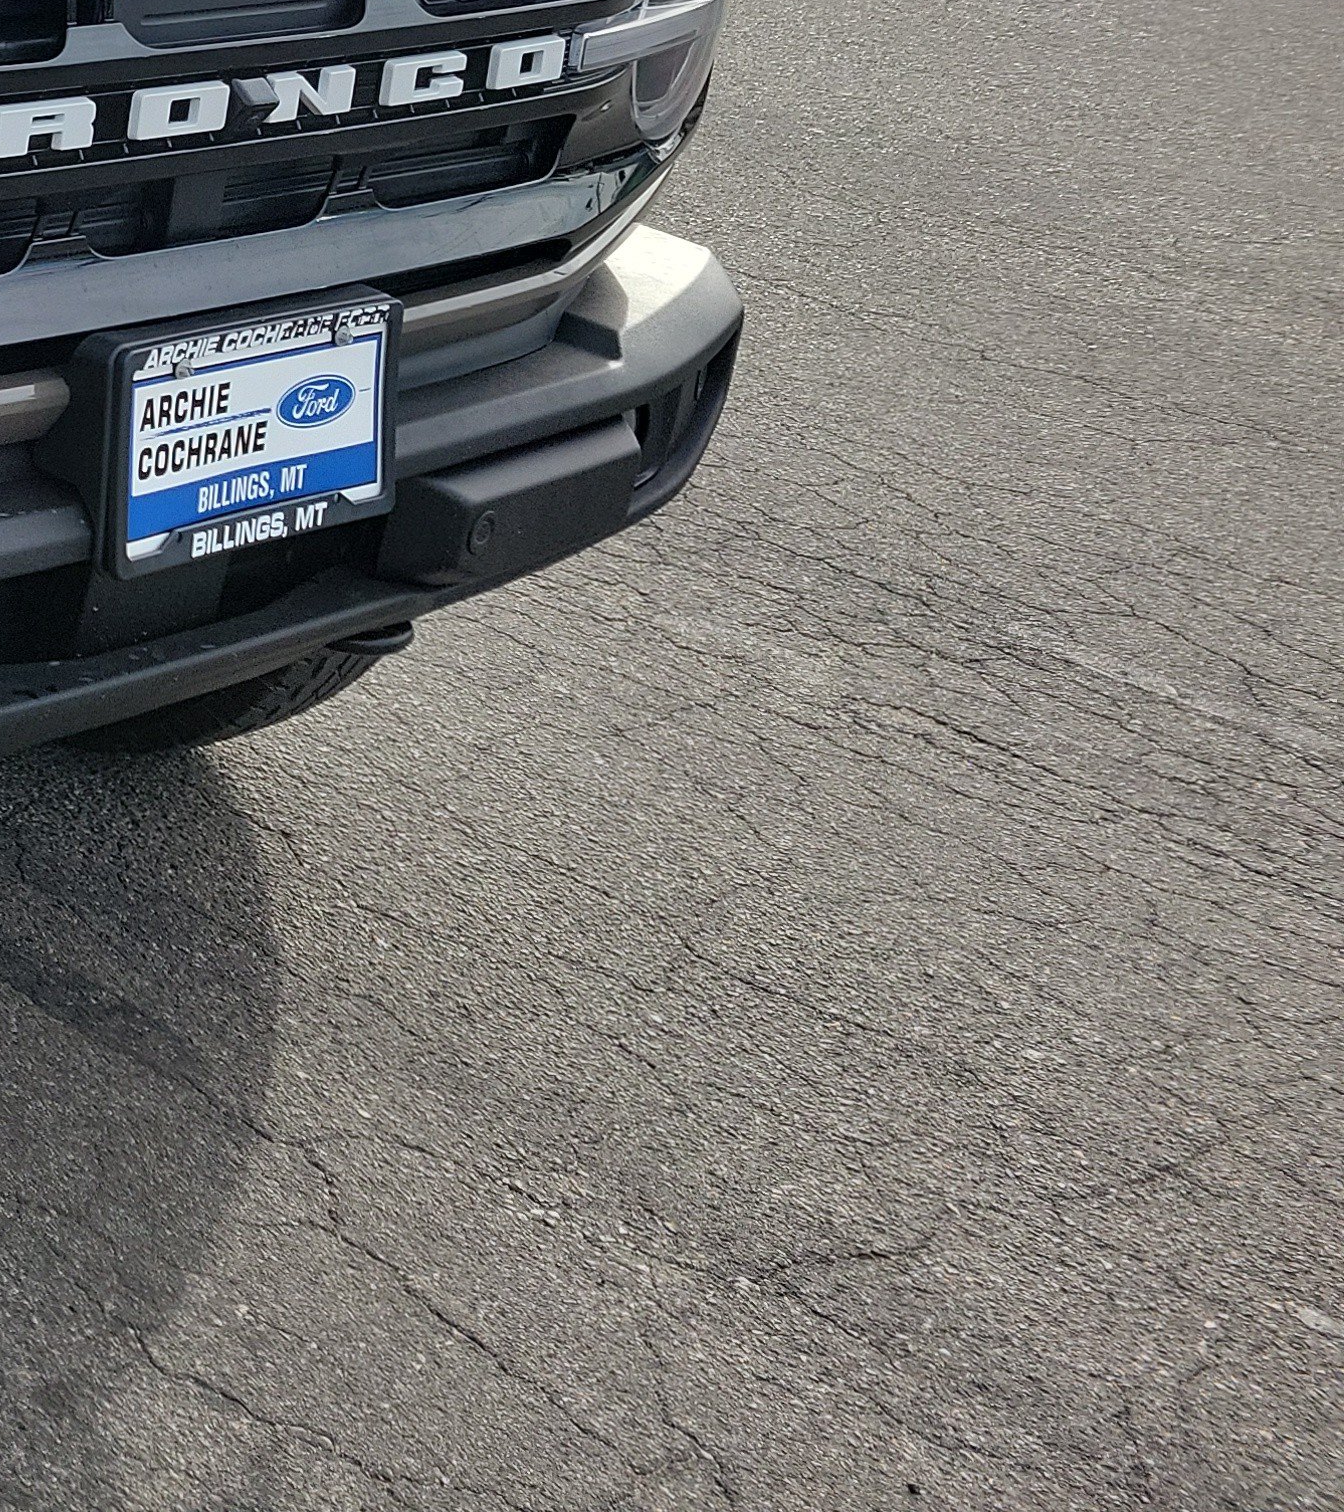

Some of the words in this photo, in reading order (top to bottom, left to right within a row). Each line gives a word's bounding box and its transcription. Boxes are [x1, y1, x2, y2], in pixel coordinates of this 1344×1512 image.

[143, 335, 220, 370] ARCHIE
[140, 382, 230, 432] ARCHIE
[292, 383, 340, 419] Ford
[138, 420, 268, 480] COCHRANE
[198, 471, 275, 513] BILLINGS,
[281, 464, 307, 492] MT
[191, 511, 288, 558] BILLINGS,
[295, 501, 328, 531] MT
